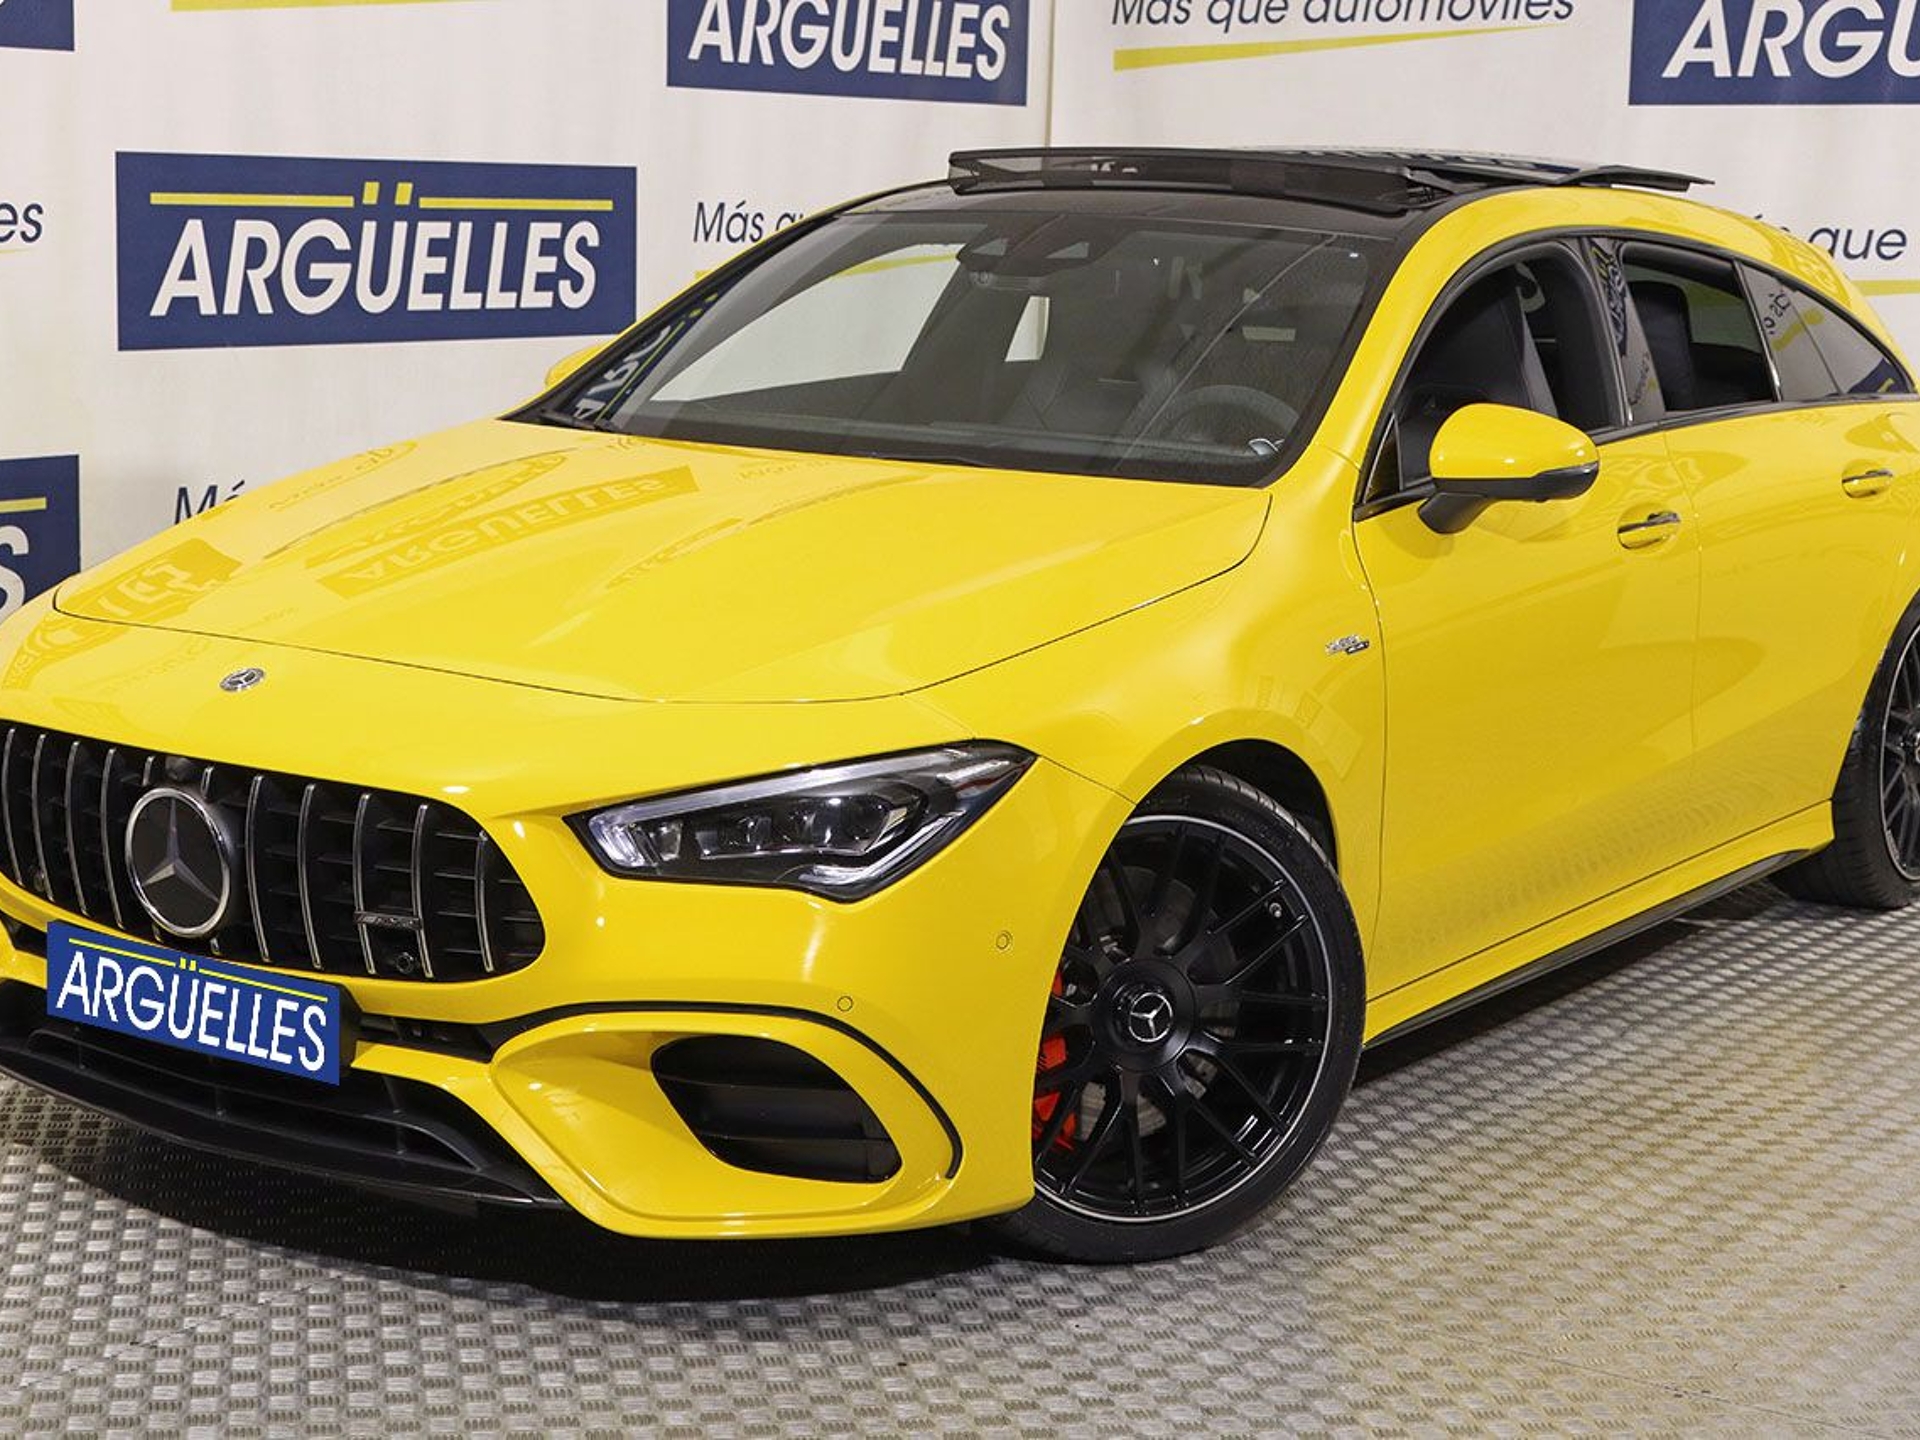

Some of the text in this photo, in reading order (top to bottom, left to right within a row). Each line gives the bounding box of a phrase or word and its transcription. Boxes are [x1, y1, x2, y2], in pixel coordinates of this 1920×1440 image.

[1207, 0, 1289, 32] que
[150, 181, 601, 317] ARGÜELLES
[693, 200, 764, 243] Más
[56, 951, 326, 1071] ARGÜELLES
